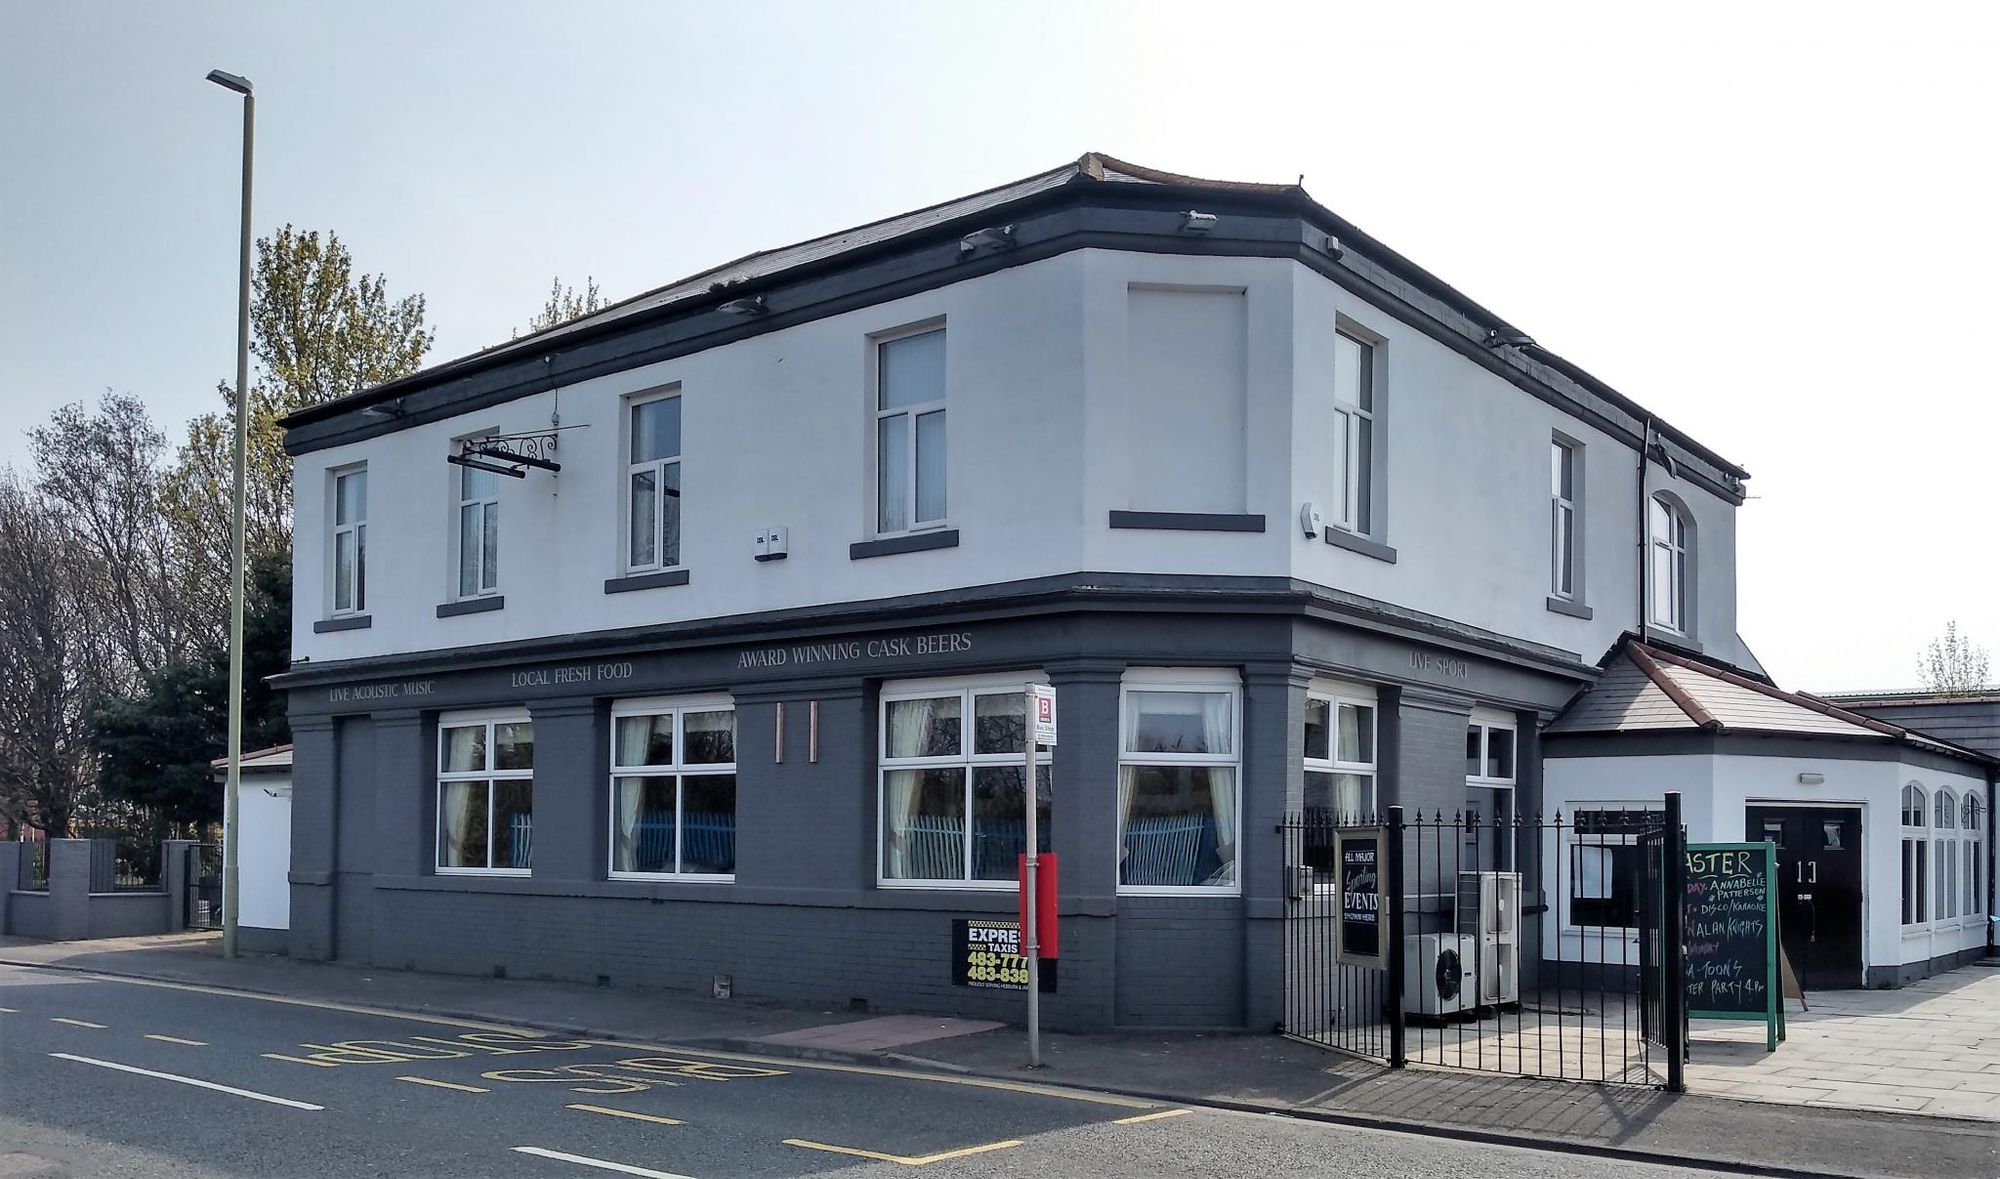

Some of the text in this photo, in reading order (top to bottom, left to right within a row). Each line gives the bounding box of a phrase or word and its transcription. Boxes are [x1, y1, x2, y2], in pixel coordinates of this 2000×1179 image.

[737, 632, 973, 669] AWARD WINNING CASK BEERS
[1409, 651, 1468, 679] LIVE SPORT
[511, 662, 633, 688] LOCAL FRESH FOOD
[329, 679, 436, 702] LIVE ACOUSTIC MUSIC
[1345, 852, 1375, 862] ALL MAJOR
[1346, 866, 1376, 892] Sporting
[1710, 878, 1766, 891] ANNABELLE
[1344, 892, 1379, 910] EVENTS
[1717, 887, 1766, 900] PATTERSON
[1344, 912, 1376, 922] SHOWN HERE
[969, 928, 1021, 943] EXPRE
[1696, 921, 1725, 938] ALAN
[988, 943, 1018, 953] TAXIS
[1711, 979, 1742, 1003] PARTY
